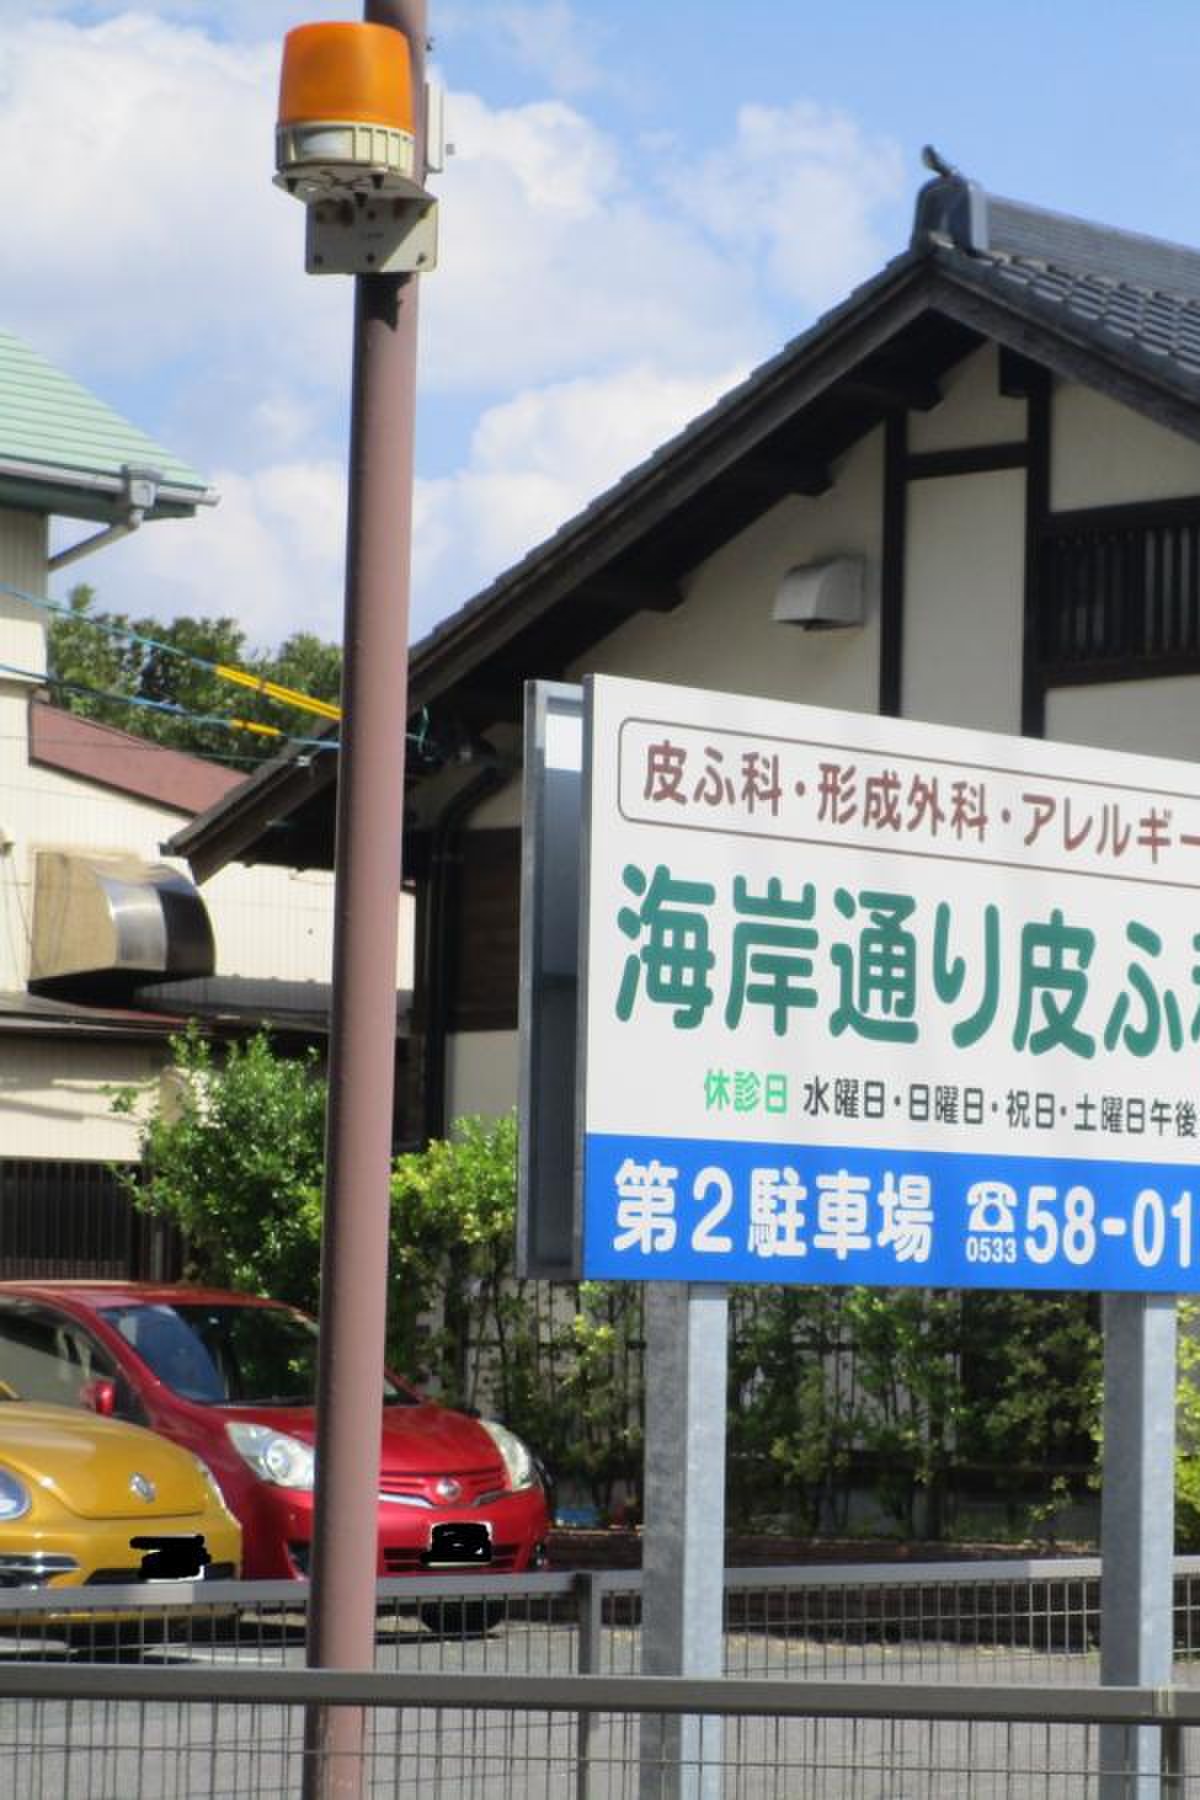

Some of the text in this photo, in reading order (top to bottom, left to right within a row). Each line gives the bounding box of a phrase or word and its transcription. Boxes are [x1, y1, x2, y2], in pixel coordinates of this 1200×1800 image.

[703, 1069, 1197, 1138] 休診日 水曜日・日曜日・祝日・土曜日午後
[613, 1158, 933, 1263] 第2駐車場
[966, 1237, 1016, 1263] 0533
